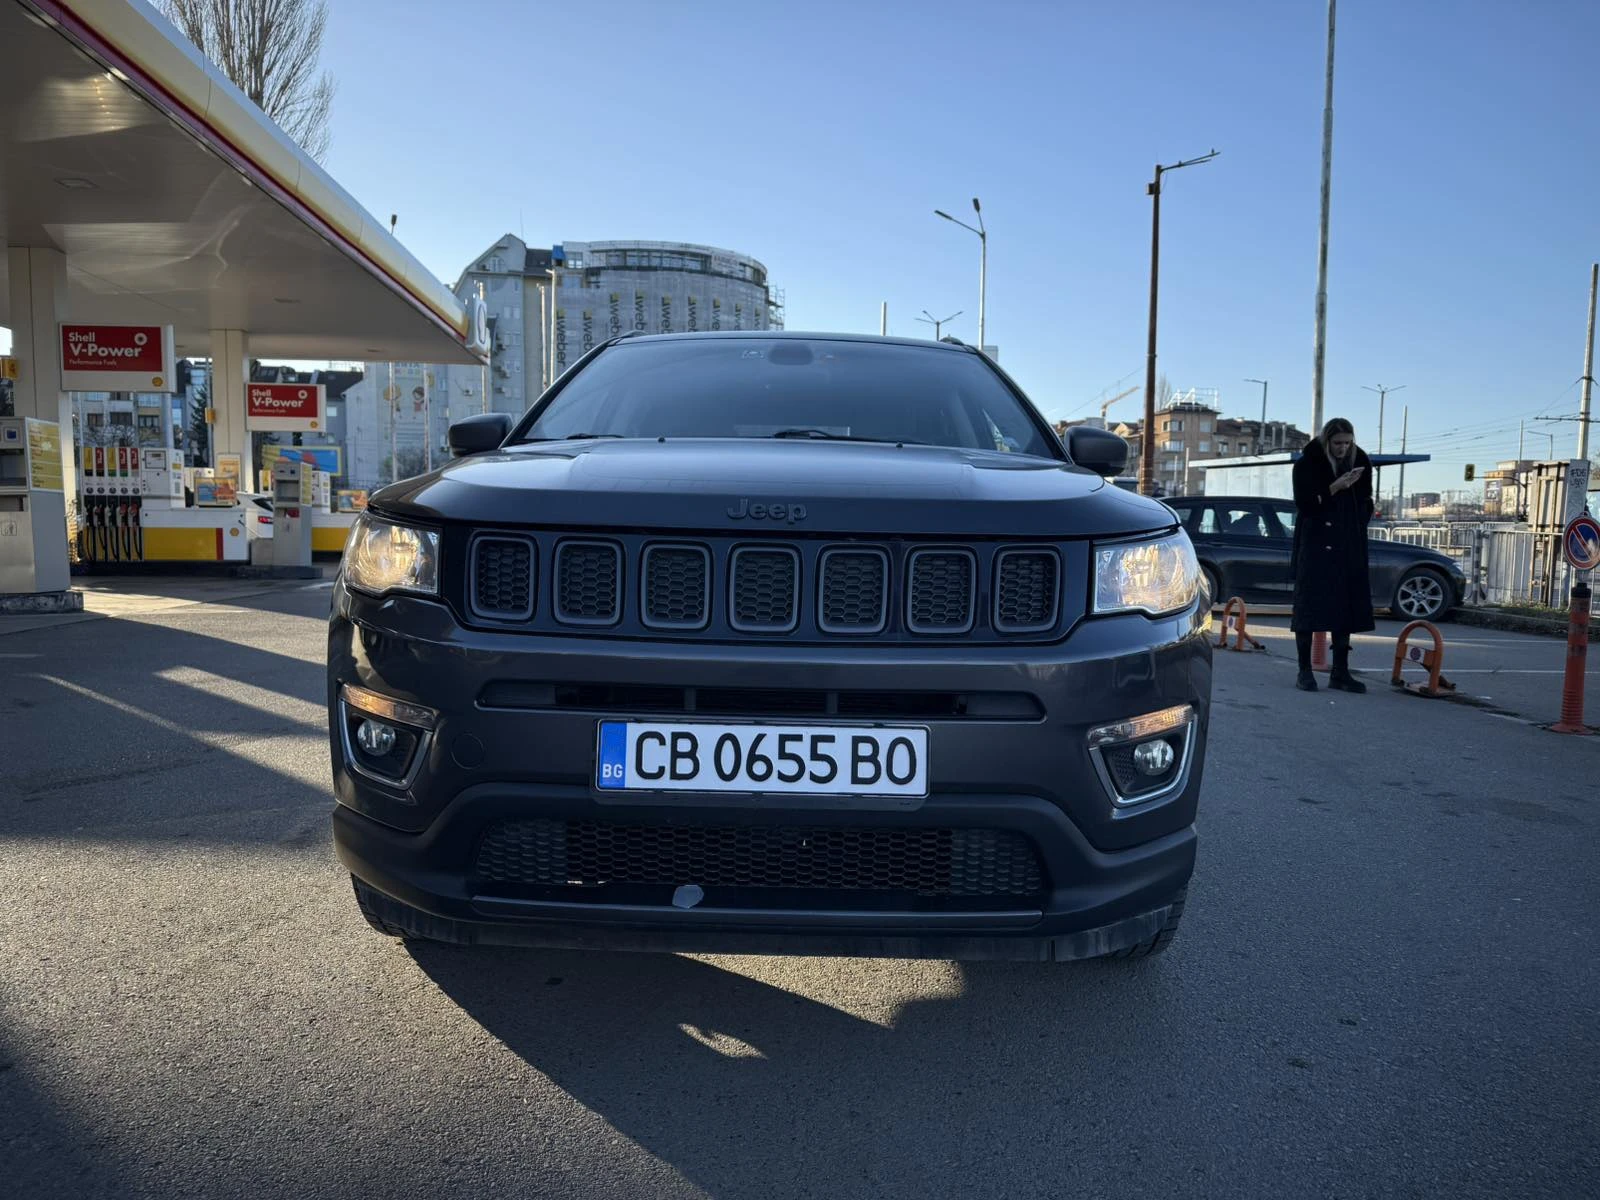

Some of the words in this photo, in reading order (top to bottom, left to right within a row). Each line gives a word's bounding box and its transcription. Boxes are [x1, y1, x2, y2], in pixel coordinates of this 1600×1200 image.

[610, 303, 622, 337] web
[635, 299, 647, 331] web
[68, 331, 96, 343] Shell
[69, 343, 142, 357] V-Power
[556, 320, 568, 366] weber
[583, 321, 594, 352] web
[252, 388, 272, 397] Shell
[252, 397, 304, 408] V-Power
[727, 498, 807, 525] Jeep
[602, 763, 623, 778] BG
[635, 731, 700, 781] CB
[713, 732, 838, 785] 0655
[850, 735, 918, 786] BO
